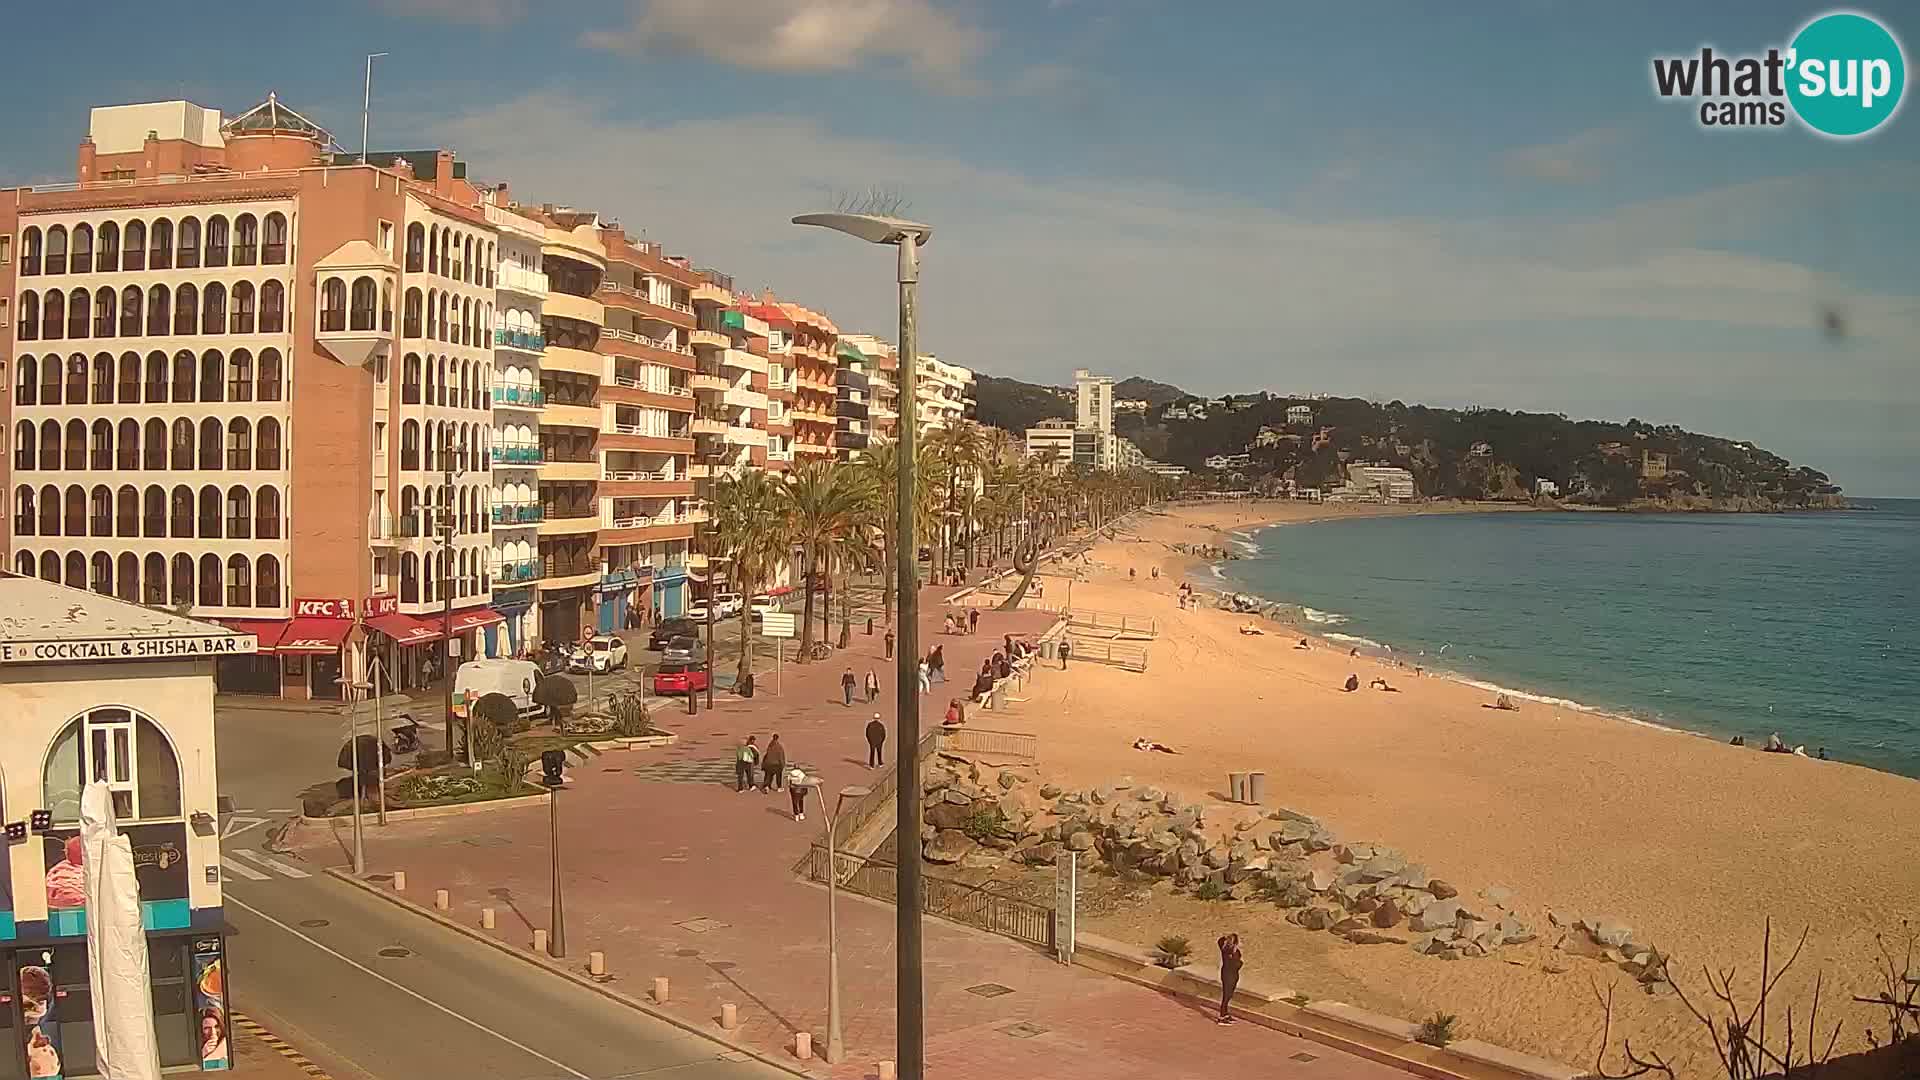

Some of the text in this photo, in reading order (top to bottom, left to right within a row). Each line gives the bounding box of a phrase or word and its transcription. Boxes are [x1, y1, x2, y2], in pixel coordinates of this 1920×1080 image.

[298, 601, 334, 615] KFC
[380, 598, 396, 612] KFC
[34, 642, 116, 658] COCKTAIL
[121, 642, 132, 656] &
[137, 639, 198, 656] SHISHA
[204, 638, 236, 653] BAR
